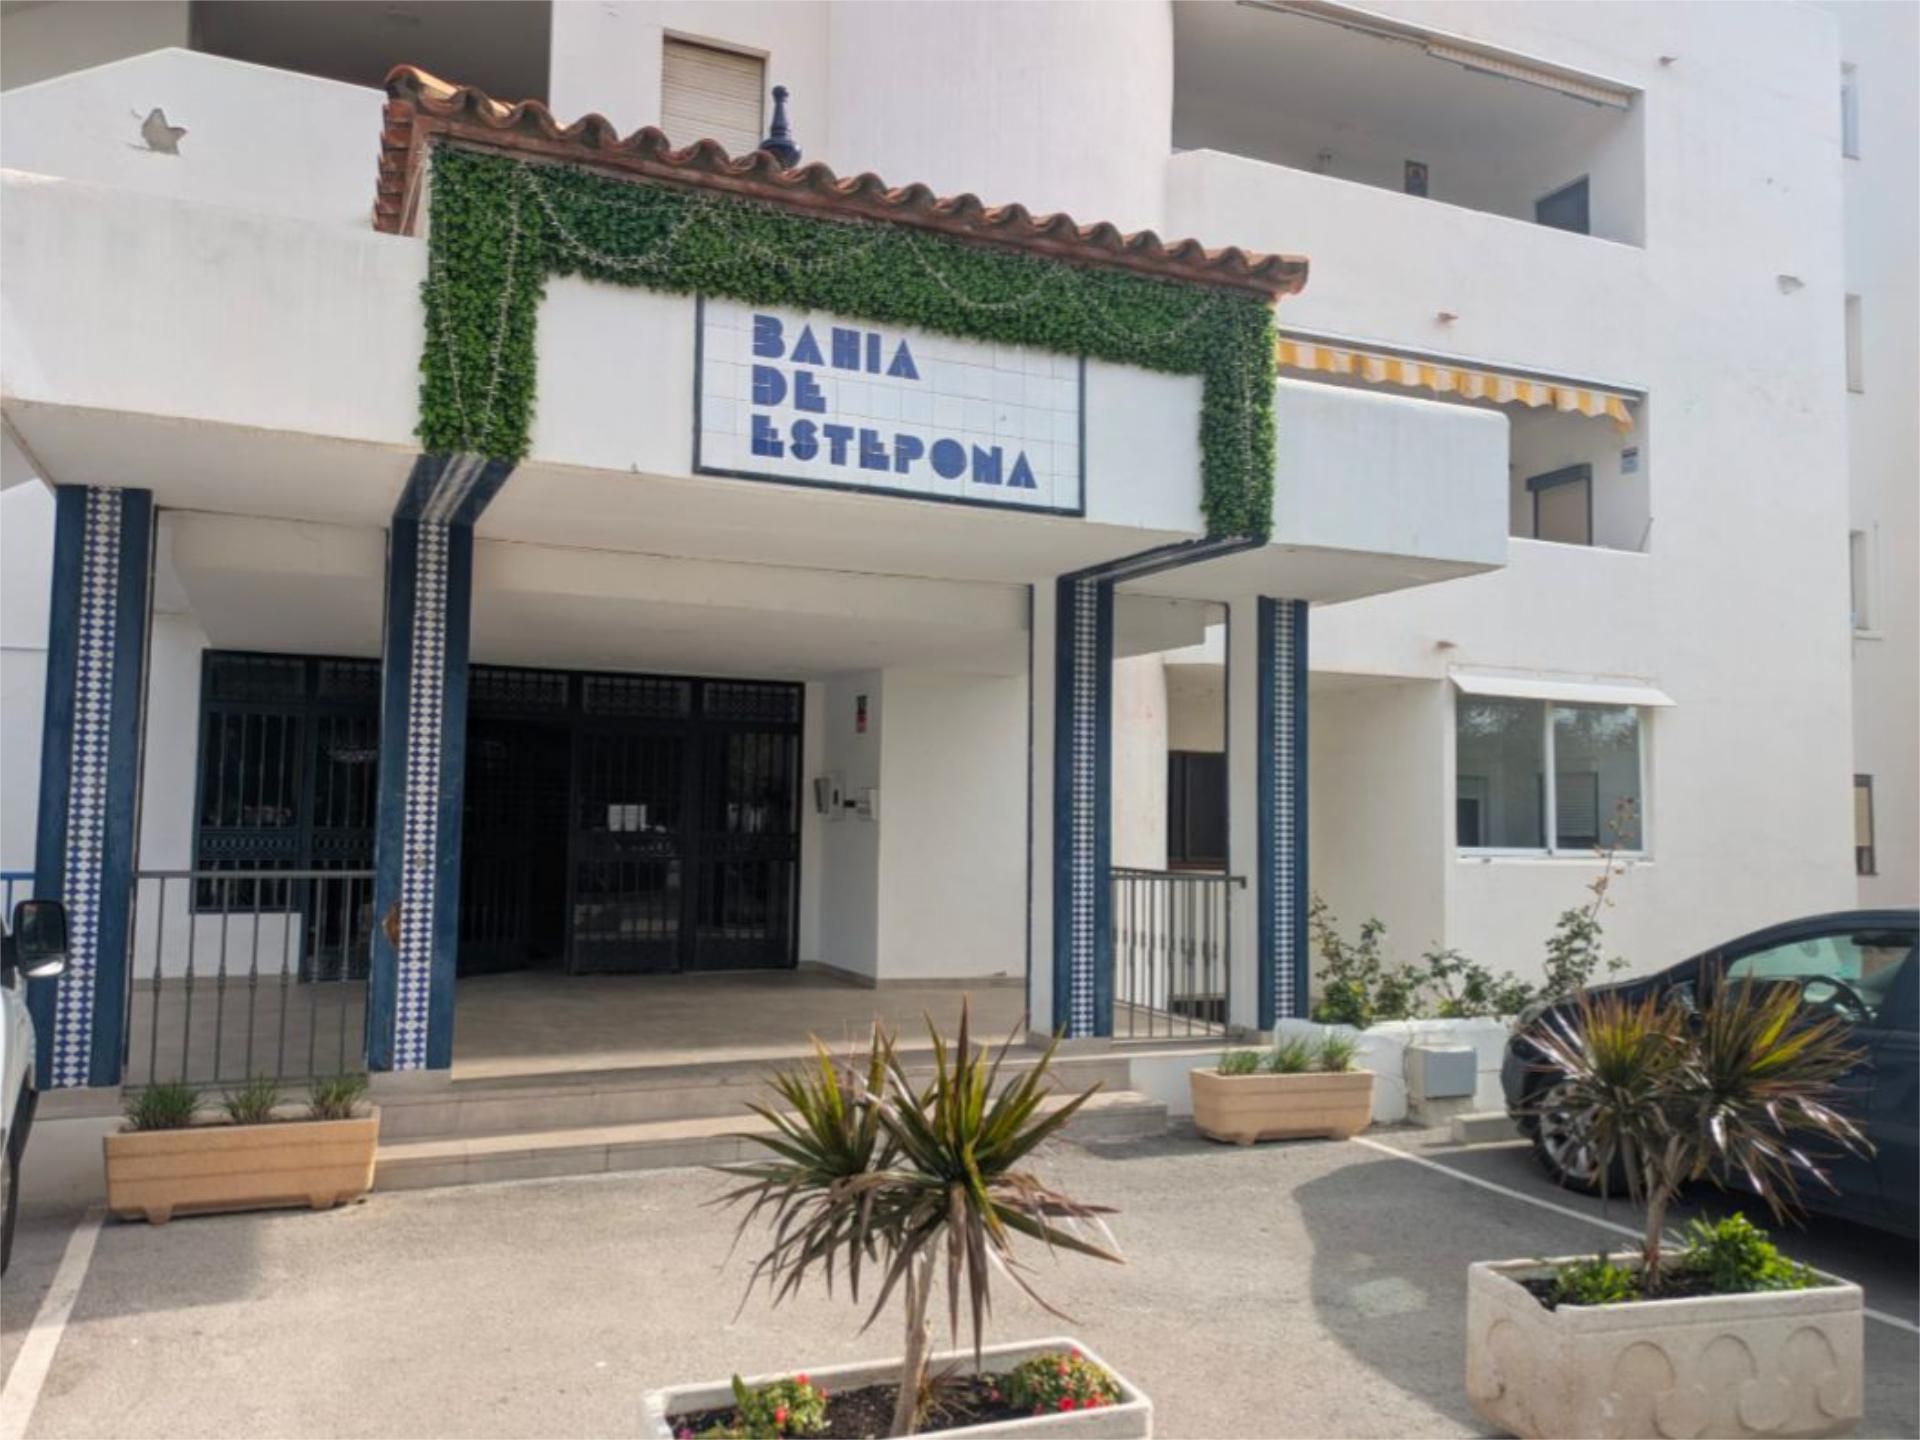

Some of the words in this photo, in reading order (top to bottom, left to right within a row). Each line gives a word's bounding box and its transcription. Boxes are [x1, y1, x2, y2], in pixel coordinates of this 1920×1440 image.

[753, 313, 920, 380] BAHIA
[752, 364, 826, 413] DE
[751, 413, 1037, 489] ESTEPONA
